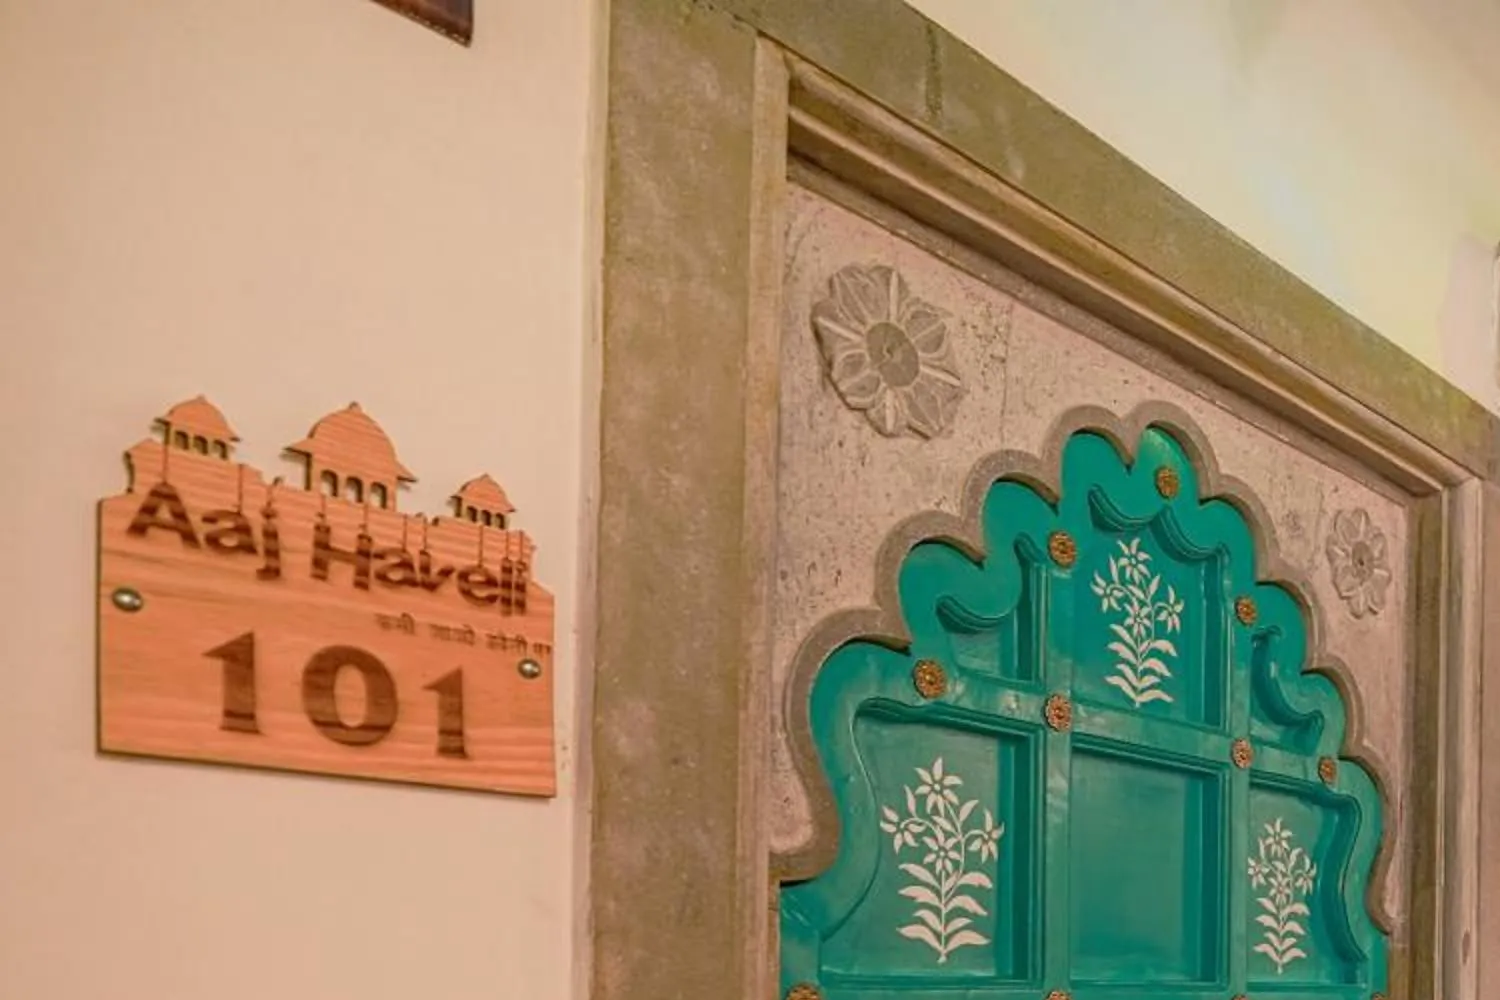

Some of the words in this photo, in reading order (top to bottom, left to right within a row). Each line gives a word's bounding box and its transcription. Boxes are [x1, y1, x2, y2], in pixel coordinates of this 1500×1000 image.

[127, 482, 281, 578] Aaj
[310, 520, 528, 616] Haveli
[203, 631, 469, 759] 101
